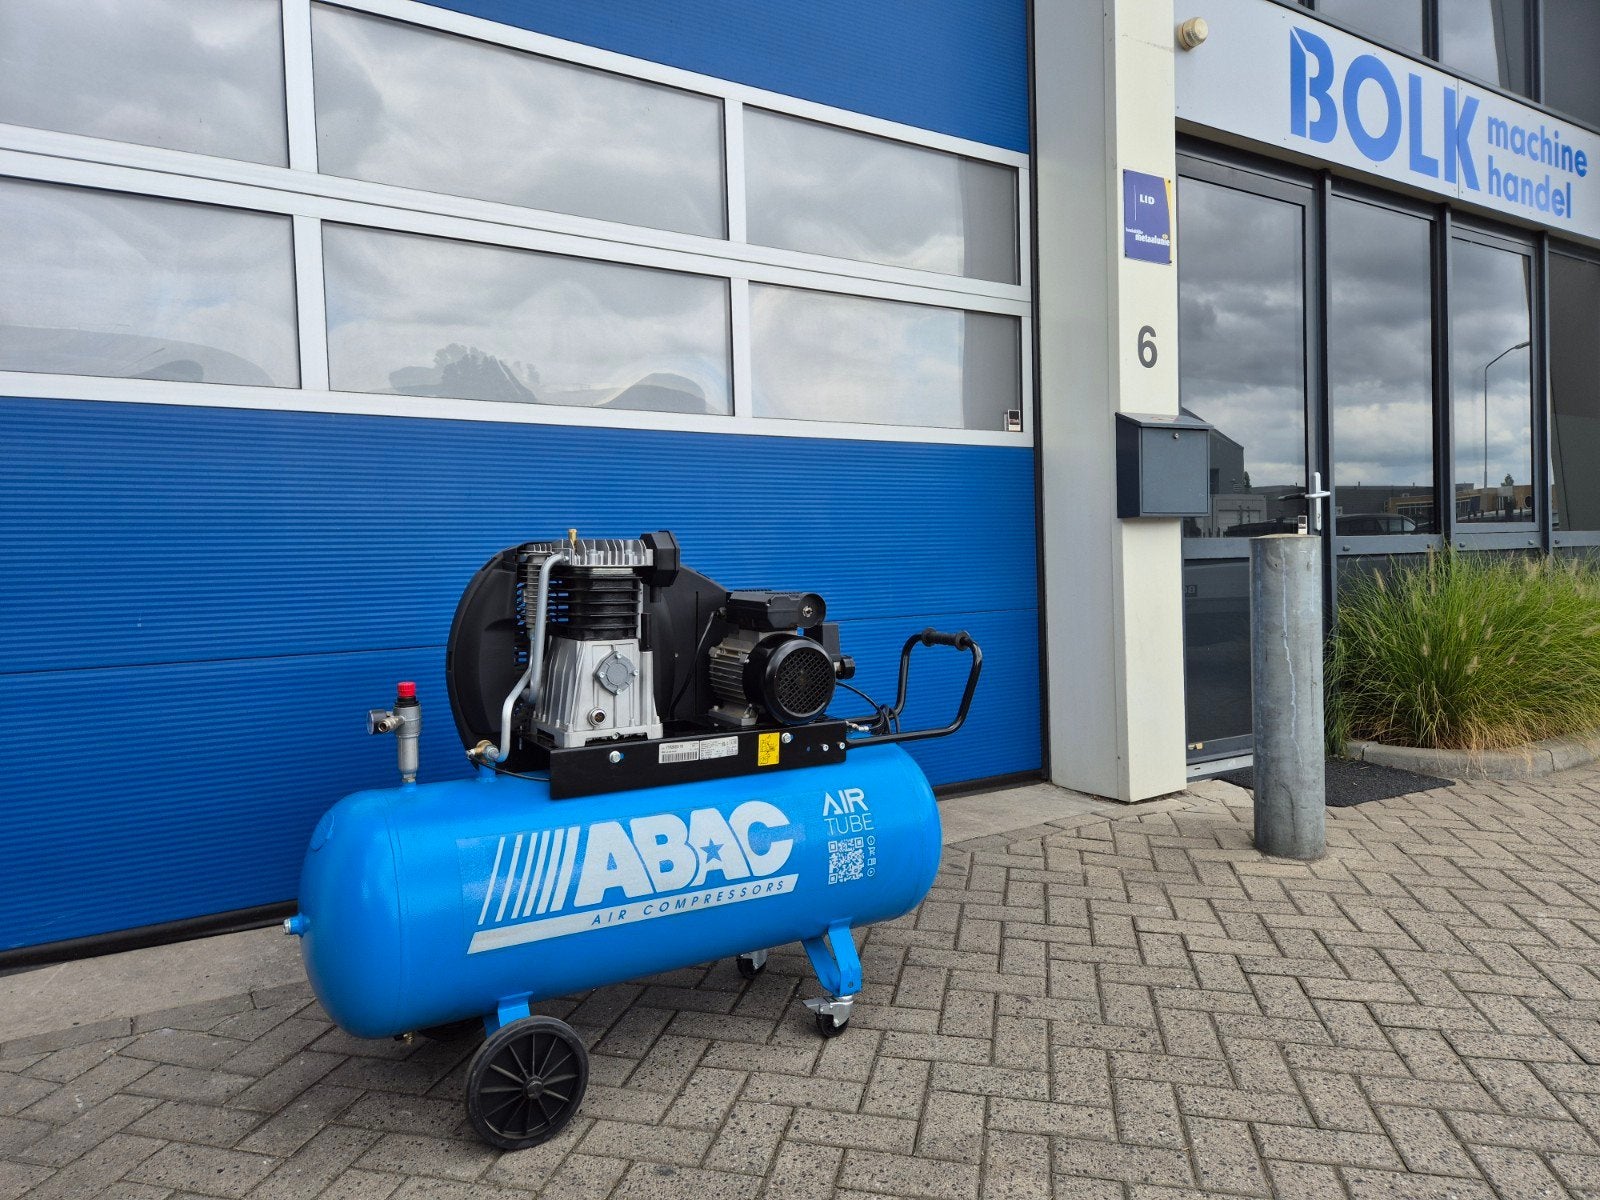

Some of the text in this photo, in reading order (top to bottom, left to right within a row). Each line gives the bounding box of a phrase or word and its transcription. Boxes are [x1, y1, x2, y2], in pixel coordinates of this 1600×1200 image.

[1290, 26, 1481, 192] BOLK
[1488, 116, 1588, 178] machine
[1140, 194, 1155, 205] LID
[1488, 155, 1571, 219] handel
[1137, 325, 1158, 369] 6
[823, 788, 869, 816] AIR
[824, 813, 874, 836] TUBE
[573, 800, 794, 907] ABAC
[592, 880, 785, 926] AIR COMPRESSORS
